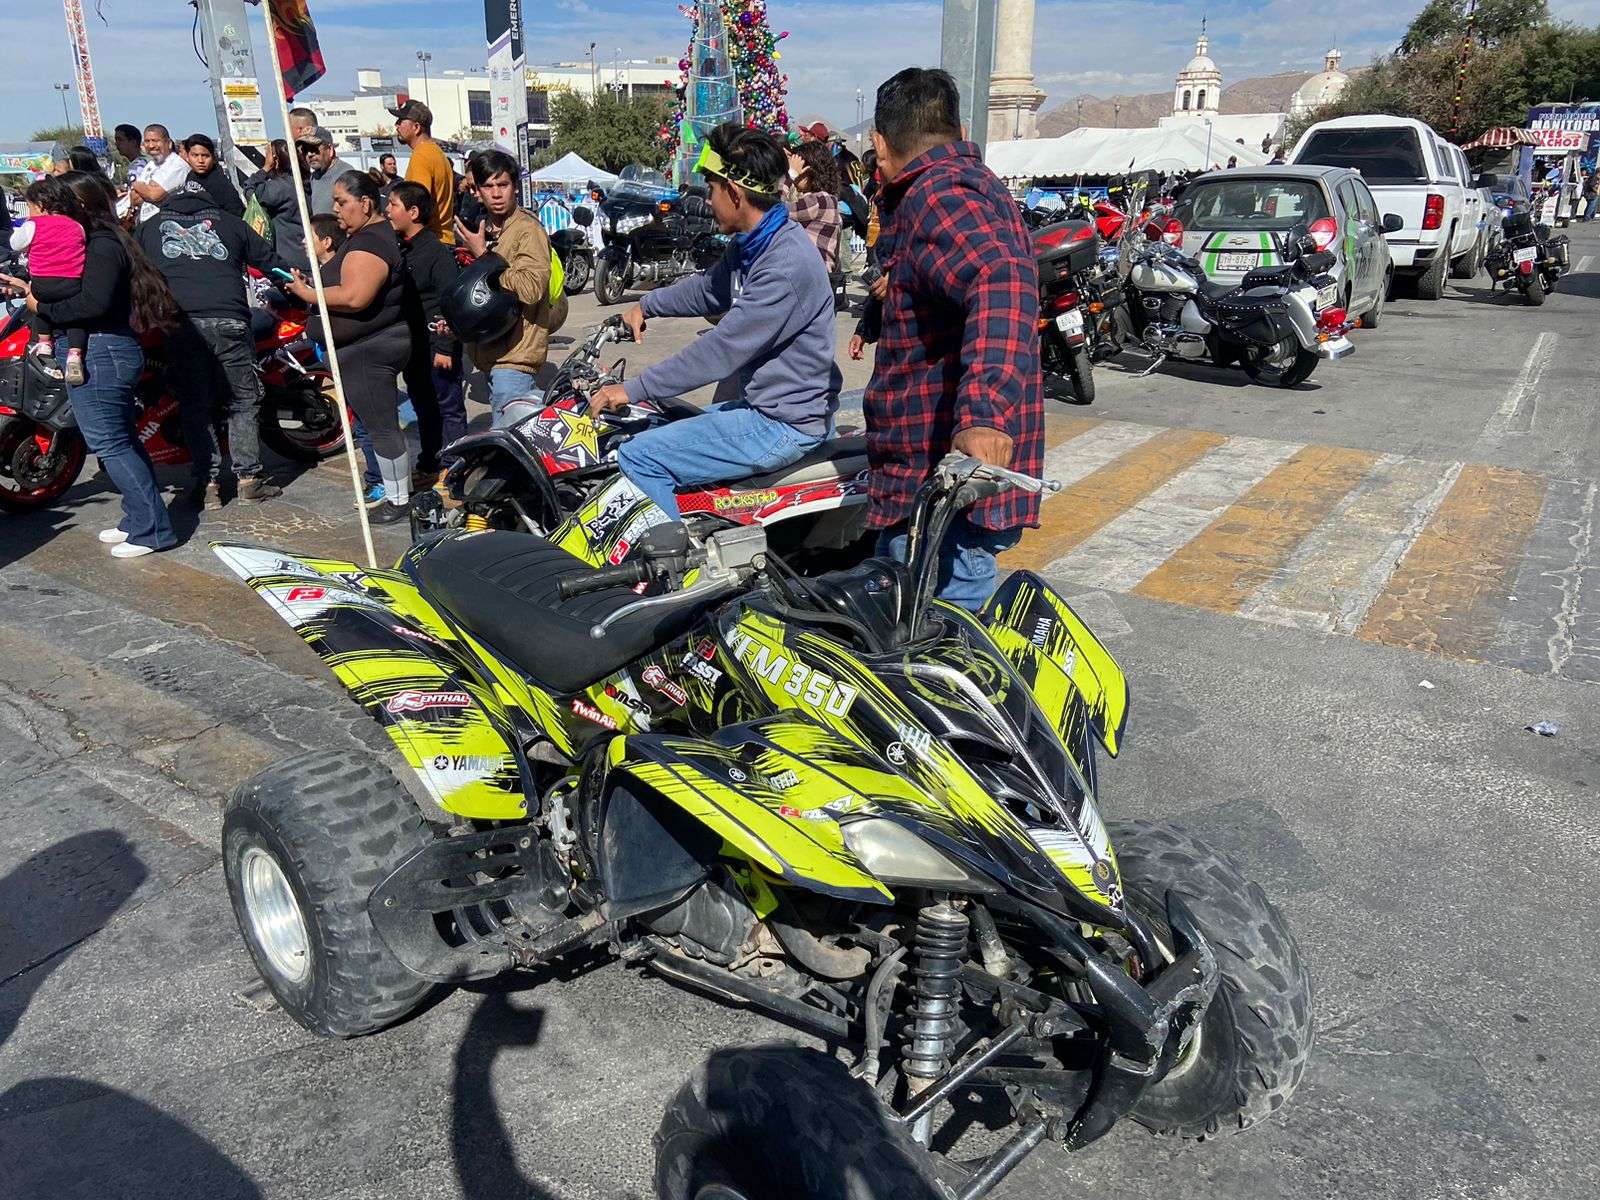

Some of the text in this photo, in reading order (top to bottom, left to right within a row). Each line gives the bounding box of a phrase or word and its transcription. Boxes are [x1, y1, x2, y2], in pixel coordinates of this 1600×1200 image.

[510, 0, 519, 40] EMER
[1531, 119, 1600, 131] MANITOBA
[1540, 138, 1580, 147] ACHOS
[452, 755, 505, 771] YAMAHA
